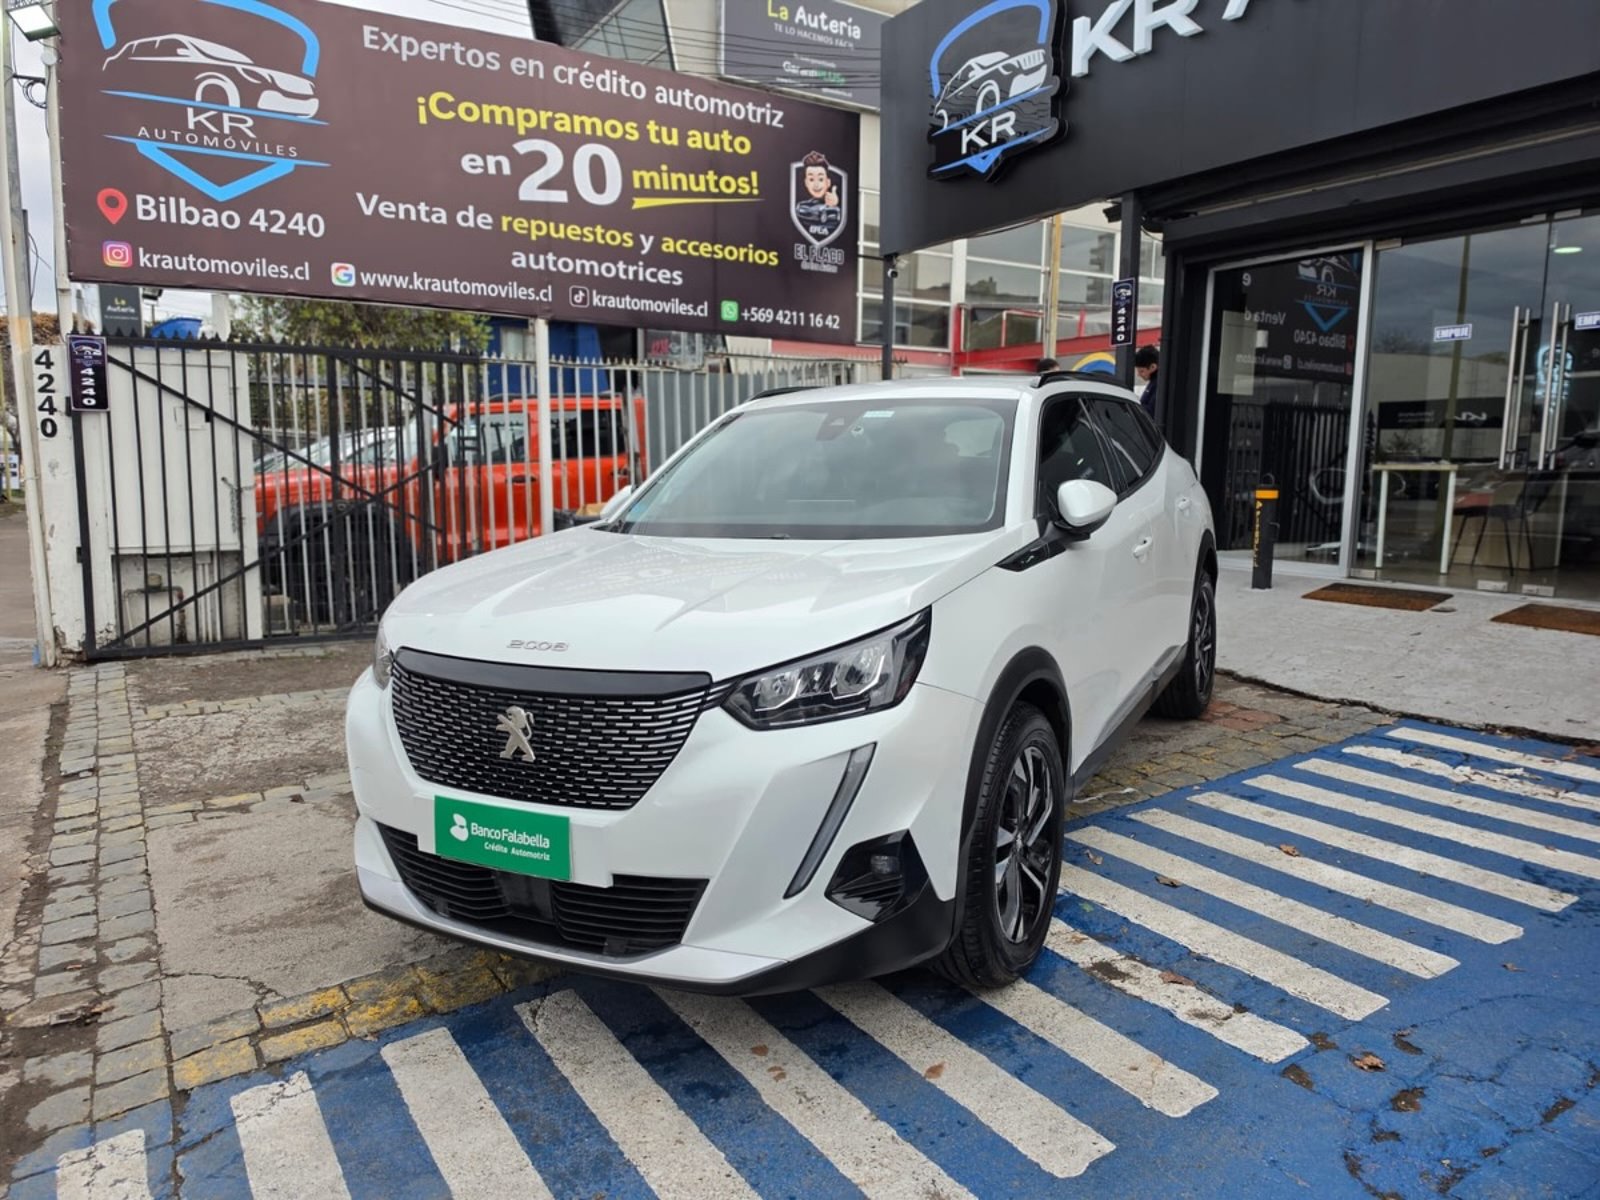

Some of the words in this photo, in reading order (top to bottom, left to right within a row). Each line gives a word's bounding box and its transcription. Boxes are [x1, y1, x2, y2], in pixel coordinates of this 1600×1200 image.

[768, 0, 789, 20] La
[795, 6, 861, 39] Autería
[363, 25, 500, 71] Expertos
[510, 56, 544, 79] en
[553, 61, 646, 99] crédito
[655, 85, 784, 128] automotriz
[186, 107, 256, 138] KR
[417, 91, 640, 141] ¡Compramos
[647, 120, 679, 146] tu
[687, 130, 752, 155] auto
[961, 111, 1017, 155] KR
[137, 126, 299, 158] AUTOMÓVILES
[461, 151, 511, 176] en
[513, 138, 623, 206] 20
[632, 164, 760, 195] minutos!
[136, 193, 241, 231] Bilbao
[249, 207, 326, 239] 4240
[356, 192, 448, 225] Venta
[456, 205, 494, 230] de
[501, 214, 634, 248] repuestos
[640, 233, 655, 255] y
[661, 236, 779, 266] accesorios
[138, 247, 310, 281] krautomoviles.cl
[511, 250, 684, 286] automotrices
[360, 271, 553, 302] www.krautomoviles.cl
[592, 289, 709, 318] krautomoviles.cl
[740, 307, 774, 324] +569
[775, 309, 806, 326] 4211
[809, 312, 824, 328] 16
[825, 314, 841, 330] 42
[1116, 307, 1126, 341] 4240
[34, 349, 58, 438] 4240
[80, 367, 97, 406] 4240
[471, 822, 501, 840] Banco
[501, 828, 550, 849] Falabella
